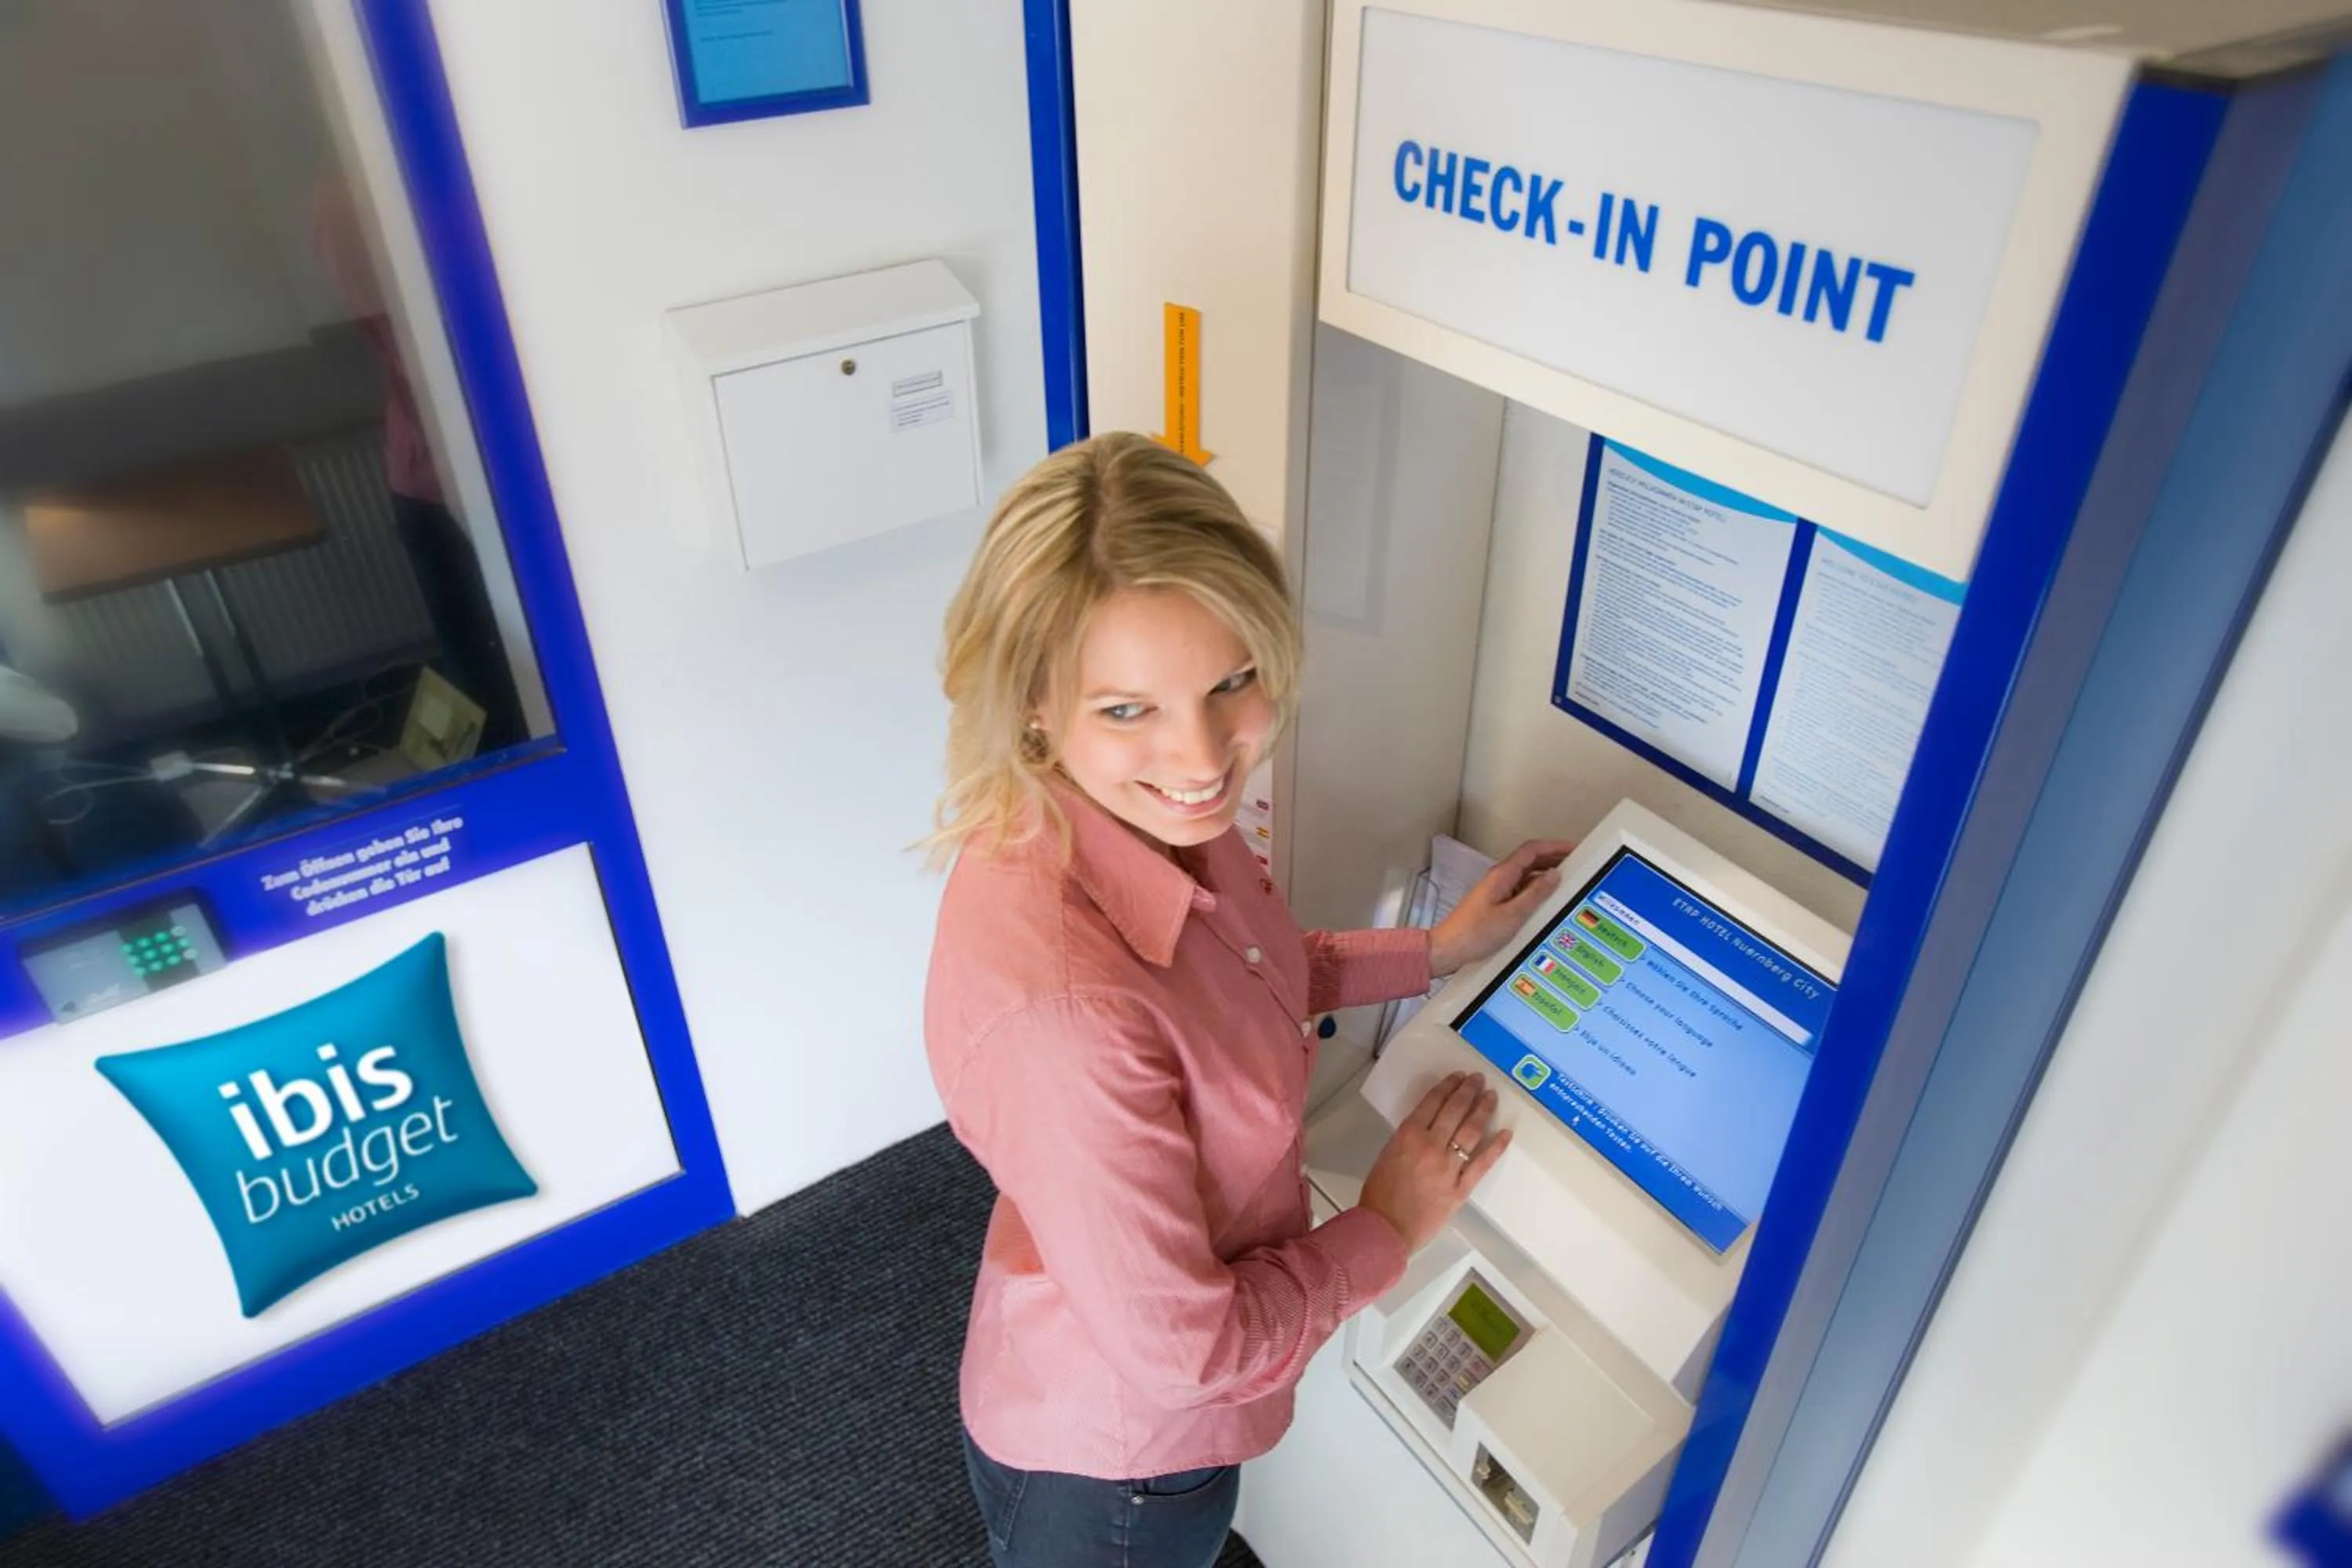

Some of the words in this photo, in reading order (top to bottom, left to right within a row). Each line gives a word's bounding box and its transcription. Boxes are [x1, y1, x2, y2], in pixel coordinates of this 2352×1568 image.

[1392, 140, 1661, 273] CHECK-IN
[1685, 216, 1915, 343] POINT
[1671, 898, 1700, 916] ETAP
[1700, 915, 1732, 941] HOTEL
[1793, 978, 1820, 1000] City
[218, 1042, 413, 1161] ibis
[236, 1094, 459, 1224] budget
[331, 1182, 420, 1232] HOTELS
